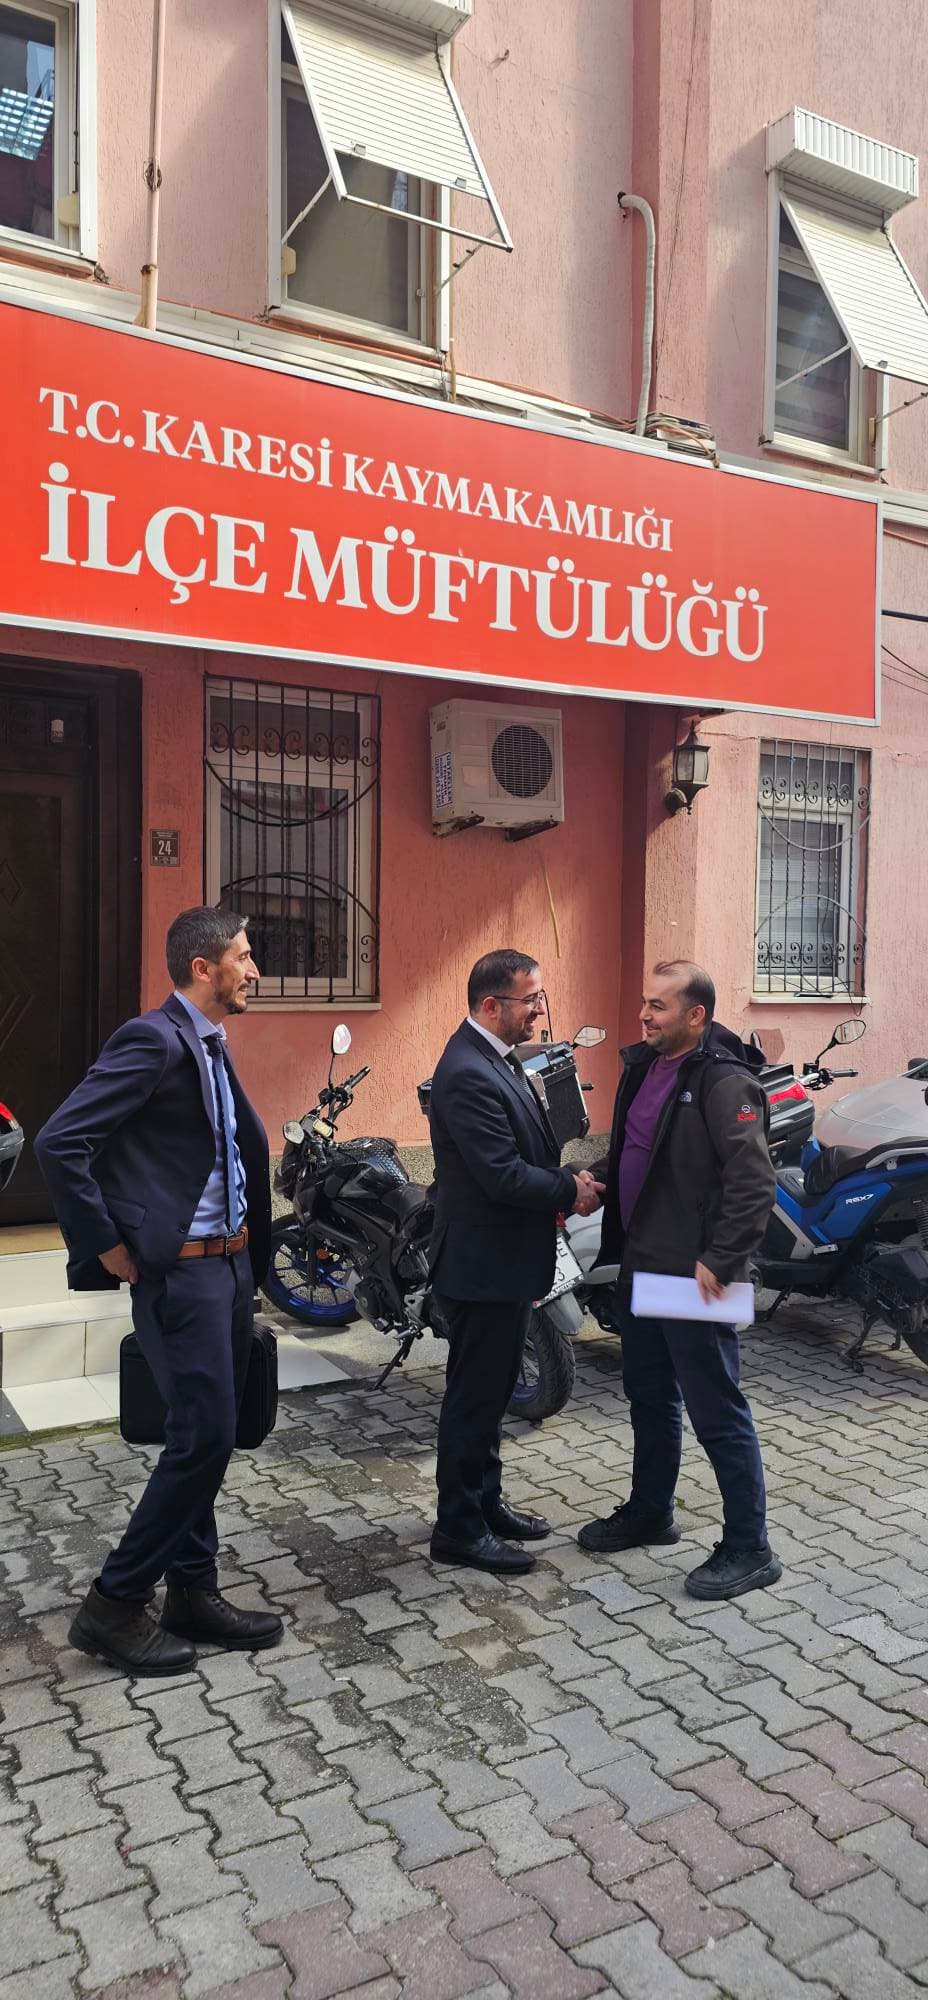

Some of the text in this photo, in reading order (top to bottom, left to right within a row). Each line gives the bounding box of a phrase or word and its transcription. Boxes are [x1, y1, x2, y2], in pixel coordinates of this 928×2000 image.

[40, 388, 674, 551] T.C. KARESİ KAYMAKAMLIĞI
[40, 463, 769, 662] İLÇE MÜFTÜLÜĞÜ
[158, 839, 172, 856] 24
